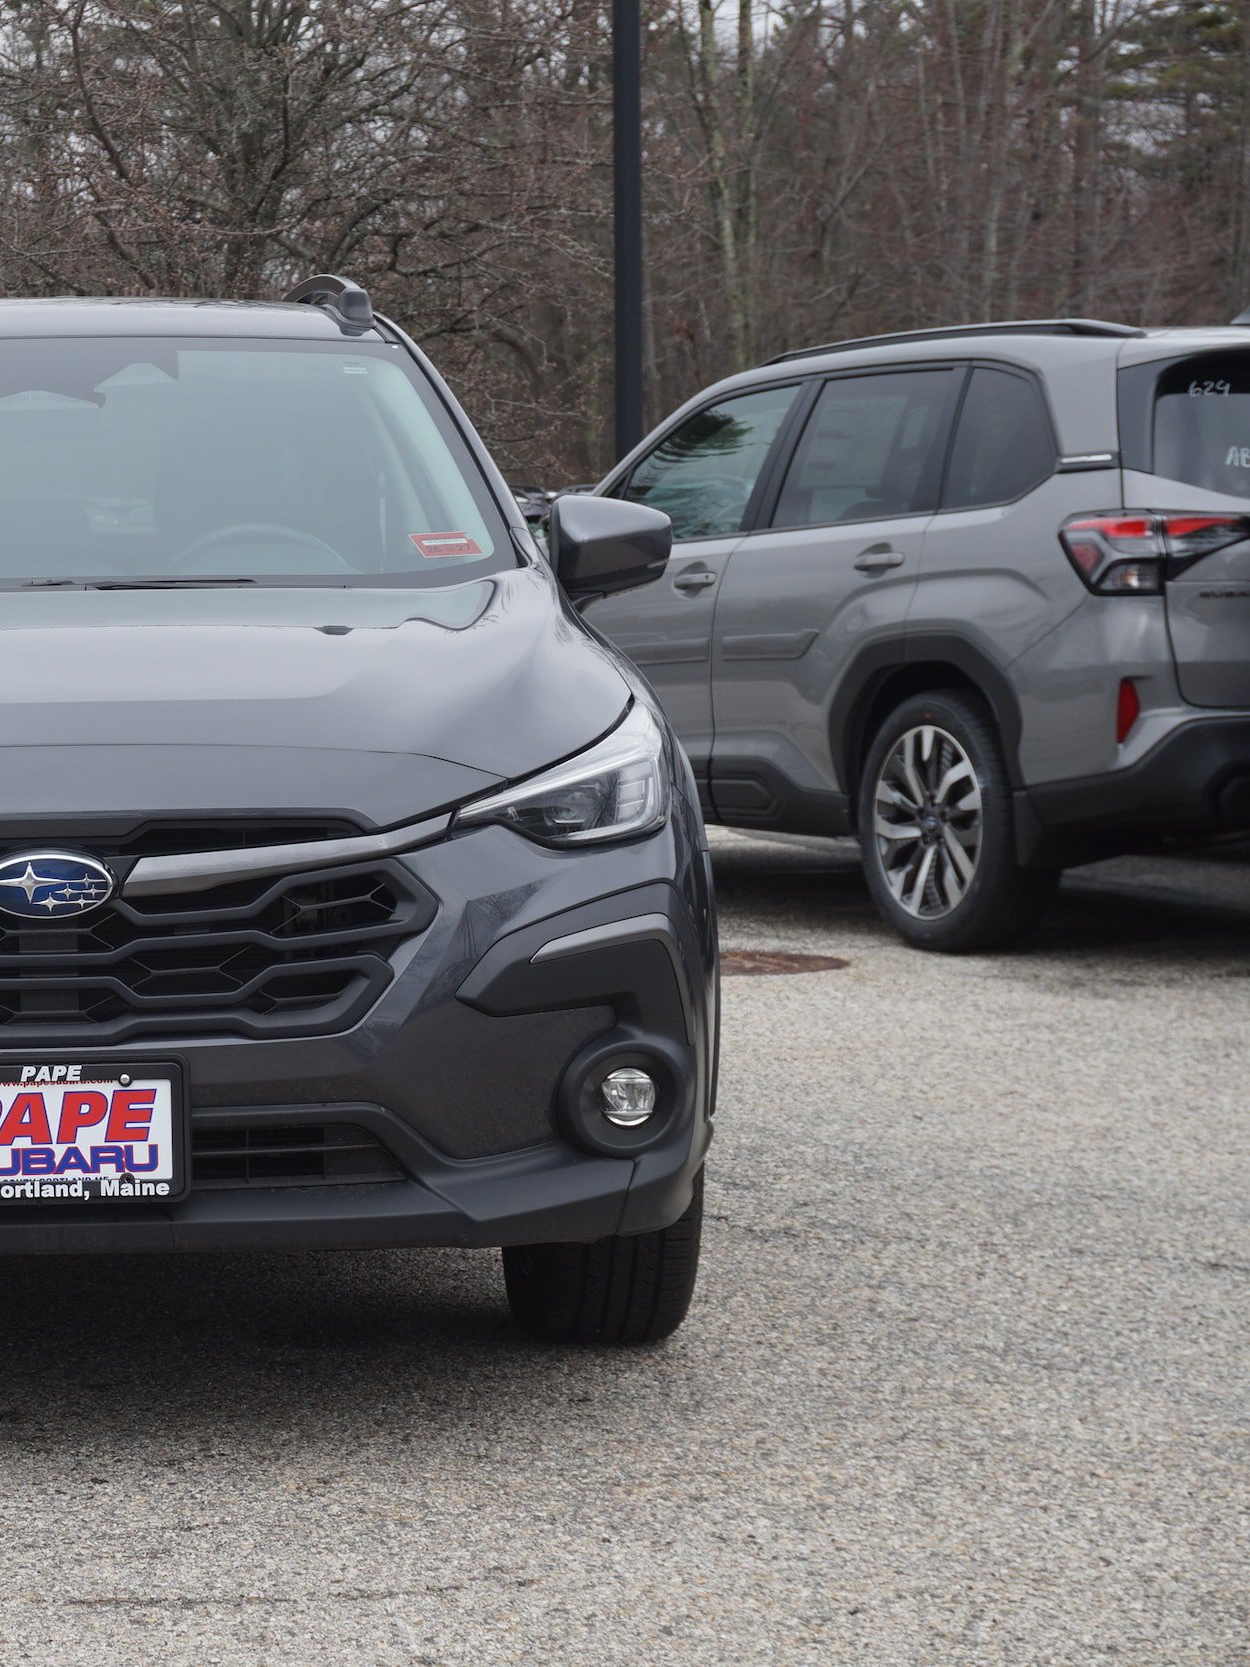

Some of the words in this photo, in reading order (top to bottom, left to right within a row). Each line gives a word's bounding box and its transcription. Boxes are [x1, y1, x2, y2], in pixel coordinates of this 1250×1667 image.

[1188, 380, 1230, 397] 629
[20, 1065, 82, 1082] PAPE
[100, 1179, 170, 1197] Maine
